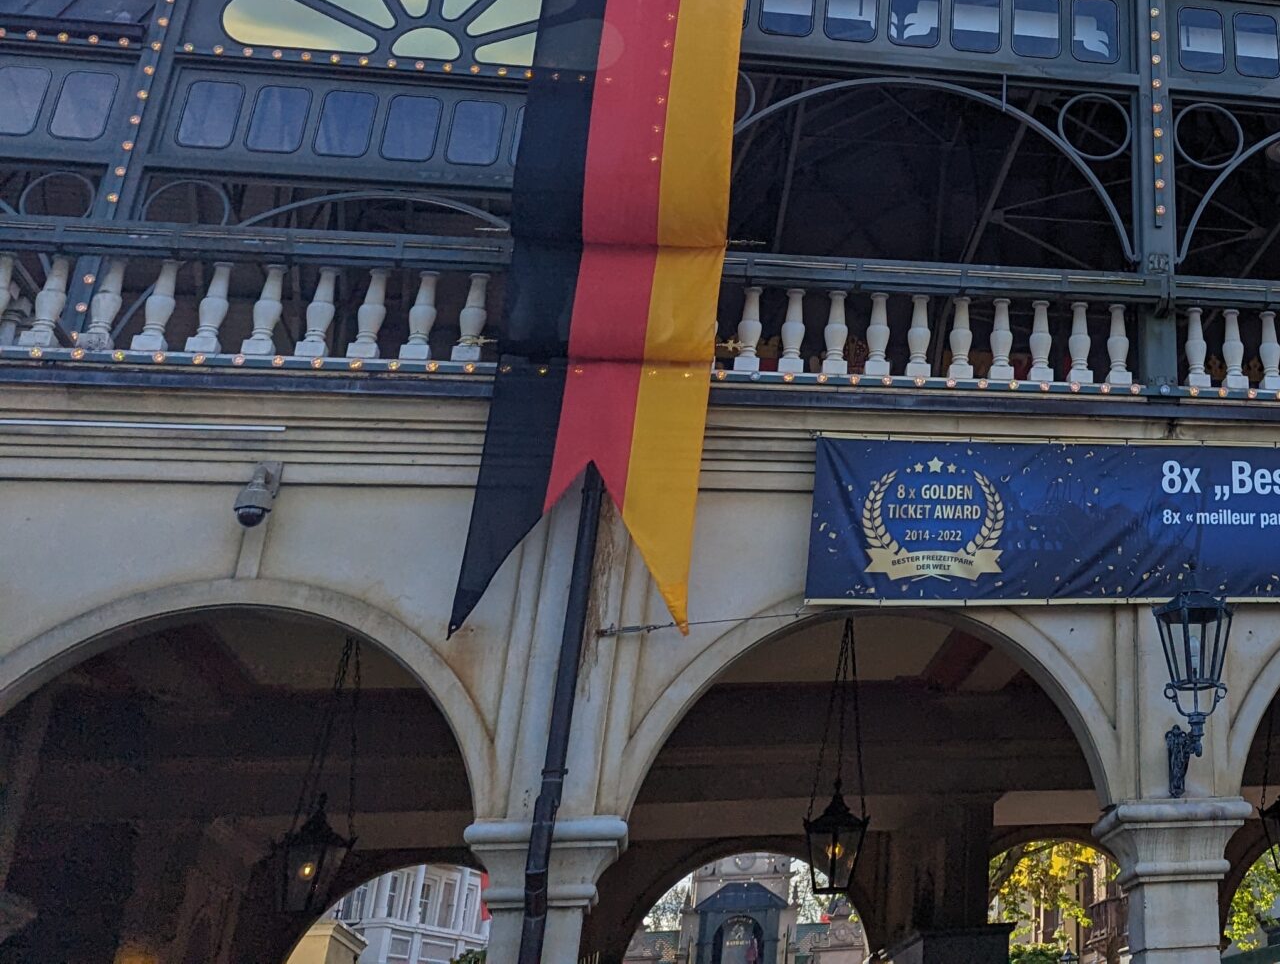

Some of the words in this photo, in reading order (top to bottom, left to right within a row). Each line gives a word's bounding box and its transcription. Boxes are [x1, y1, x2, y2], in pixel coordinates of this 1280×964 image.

[1161, 460, 1201, 494] 8x
[897, 484, 905, 499] 8
[909, 488, 916, 499] x
[921, 484, 973, 500] GOLDEN
[888, 504, 931, 519] TICKET
[934, 504, 981, 519] AWARD
[1162, 509, 1181, 525] 8x
[1197, 509, 1256, 526] meilleur
[905, 530, 929, 541] 2014
[937, 530, 962, 541] 2022
[891, 556, 920, 566] BESTER
[921, 555, 974, 567] FREIZEITPARK
[932, 563, 951, 571] WELT
